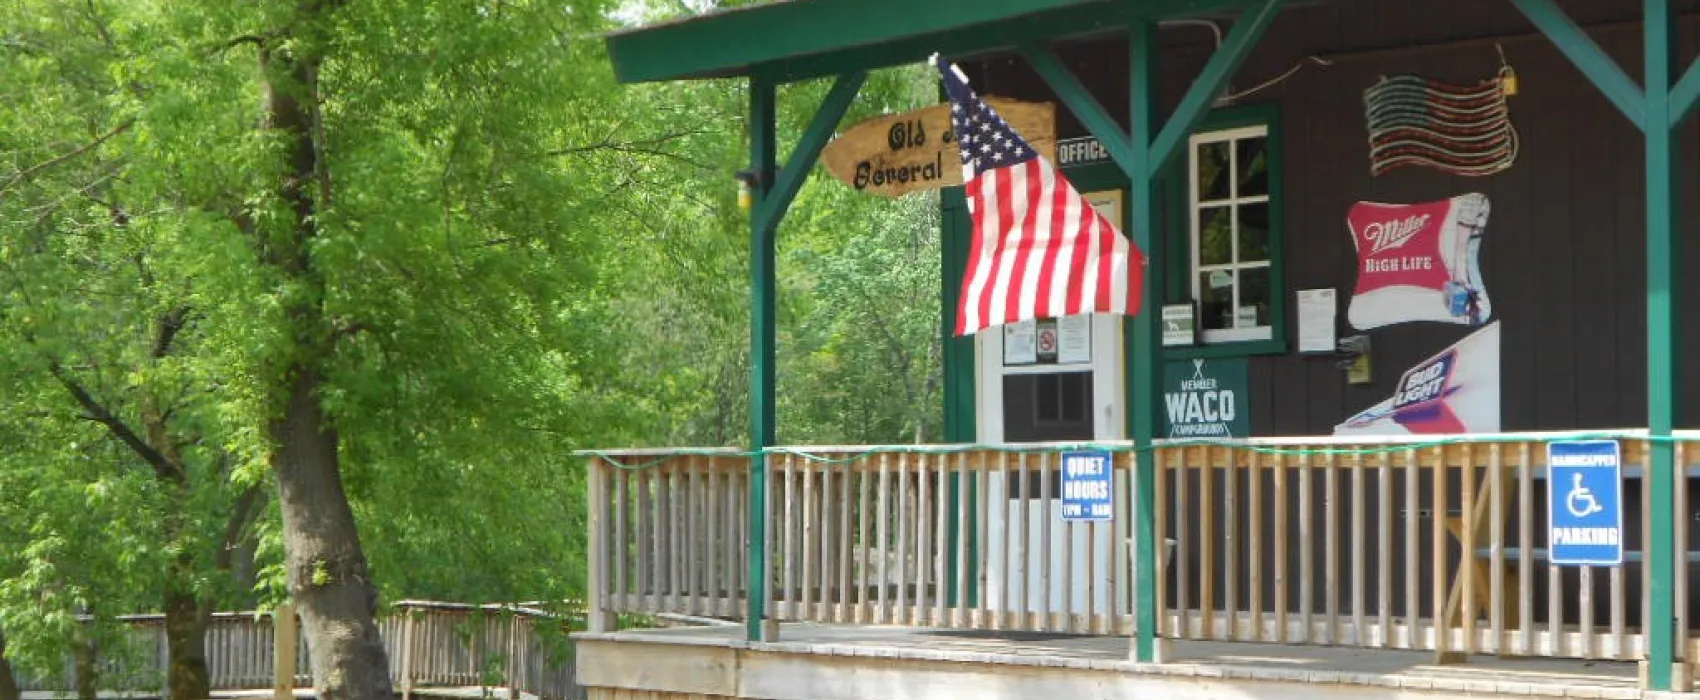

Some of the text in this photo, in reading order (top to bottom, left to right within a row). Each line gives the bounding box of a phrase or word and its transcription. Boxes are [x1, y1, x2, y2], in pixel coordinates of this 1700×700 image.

[887, 119, 926, 150] Old
[853, 151, 942, 190] General
[1364, 213, 1432, 253] Miller
[1365, 256, 1432, 273] HIGH LIFE
[1181, 378, 1217, 391] MEMBER
[1406, 361, 1445, 388] BUD
[1395, 376, 1444, 405] LIGHT
[1165, 389, 1235, 423] WACO
[1067, 456, 1105, 479] QUIET
[1551, 454, 1616, 467] HANDICAPPED
[1065, 480, 1108, 500] HOURS
[1553, 527, 1618, 546] PARKING
